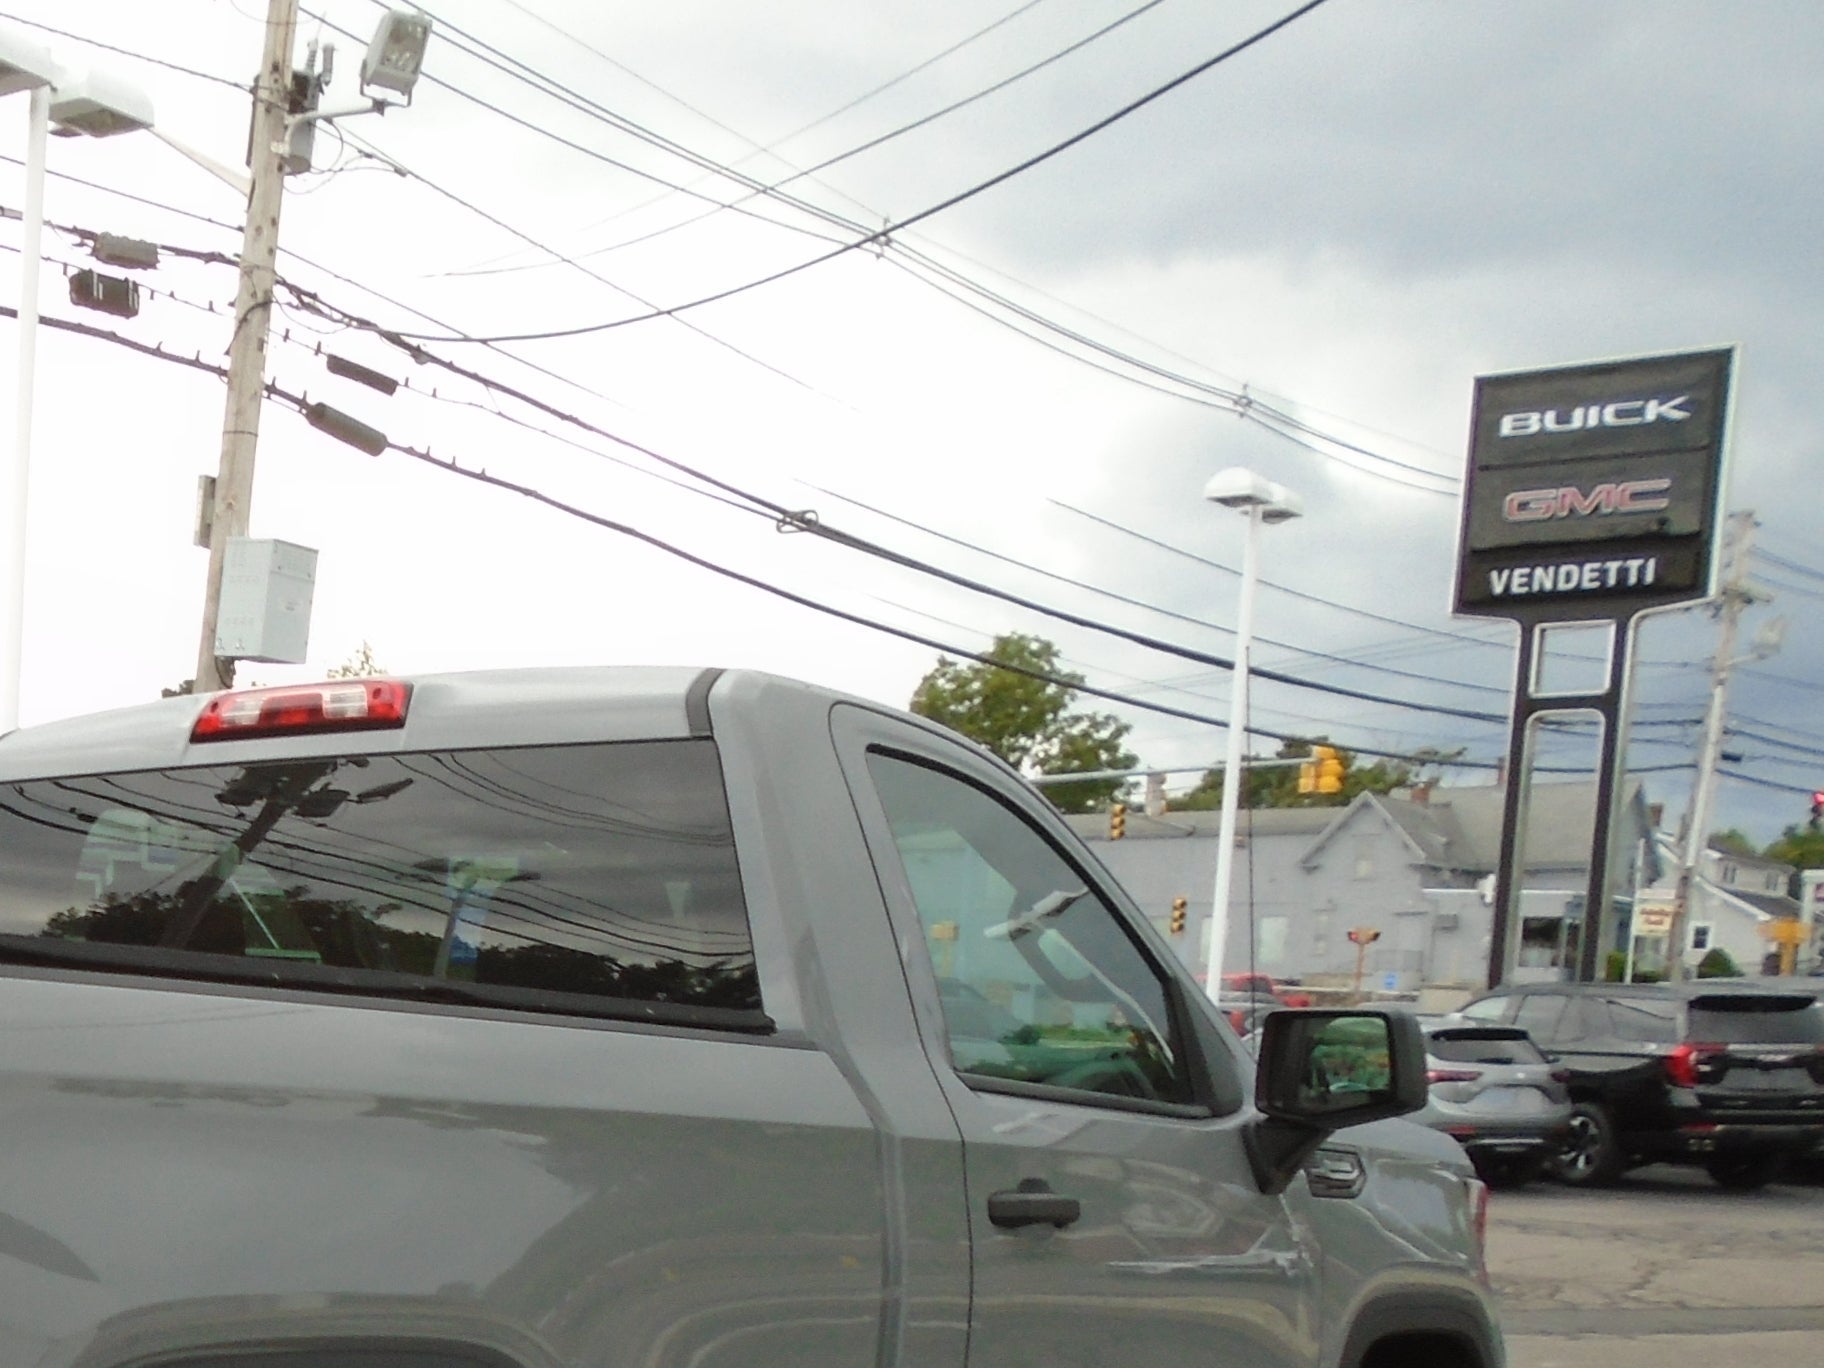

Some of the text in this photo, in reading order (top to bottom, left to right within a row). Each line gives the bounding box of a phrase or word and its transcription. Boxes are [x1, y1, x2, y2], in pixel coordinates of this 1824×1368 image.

[1499, 395, 1691, 437] BUICK
[1502, 478, 1672, 523] GMC
[1488, 557, 1656, 596] VENDETTI
